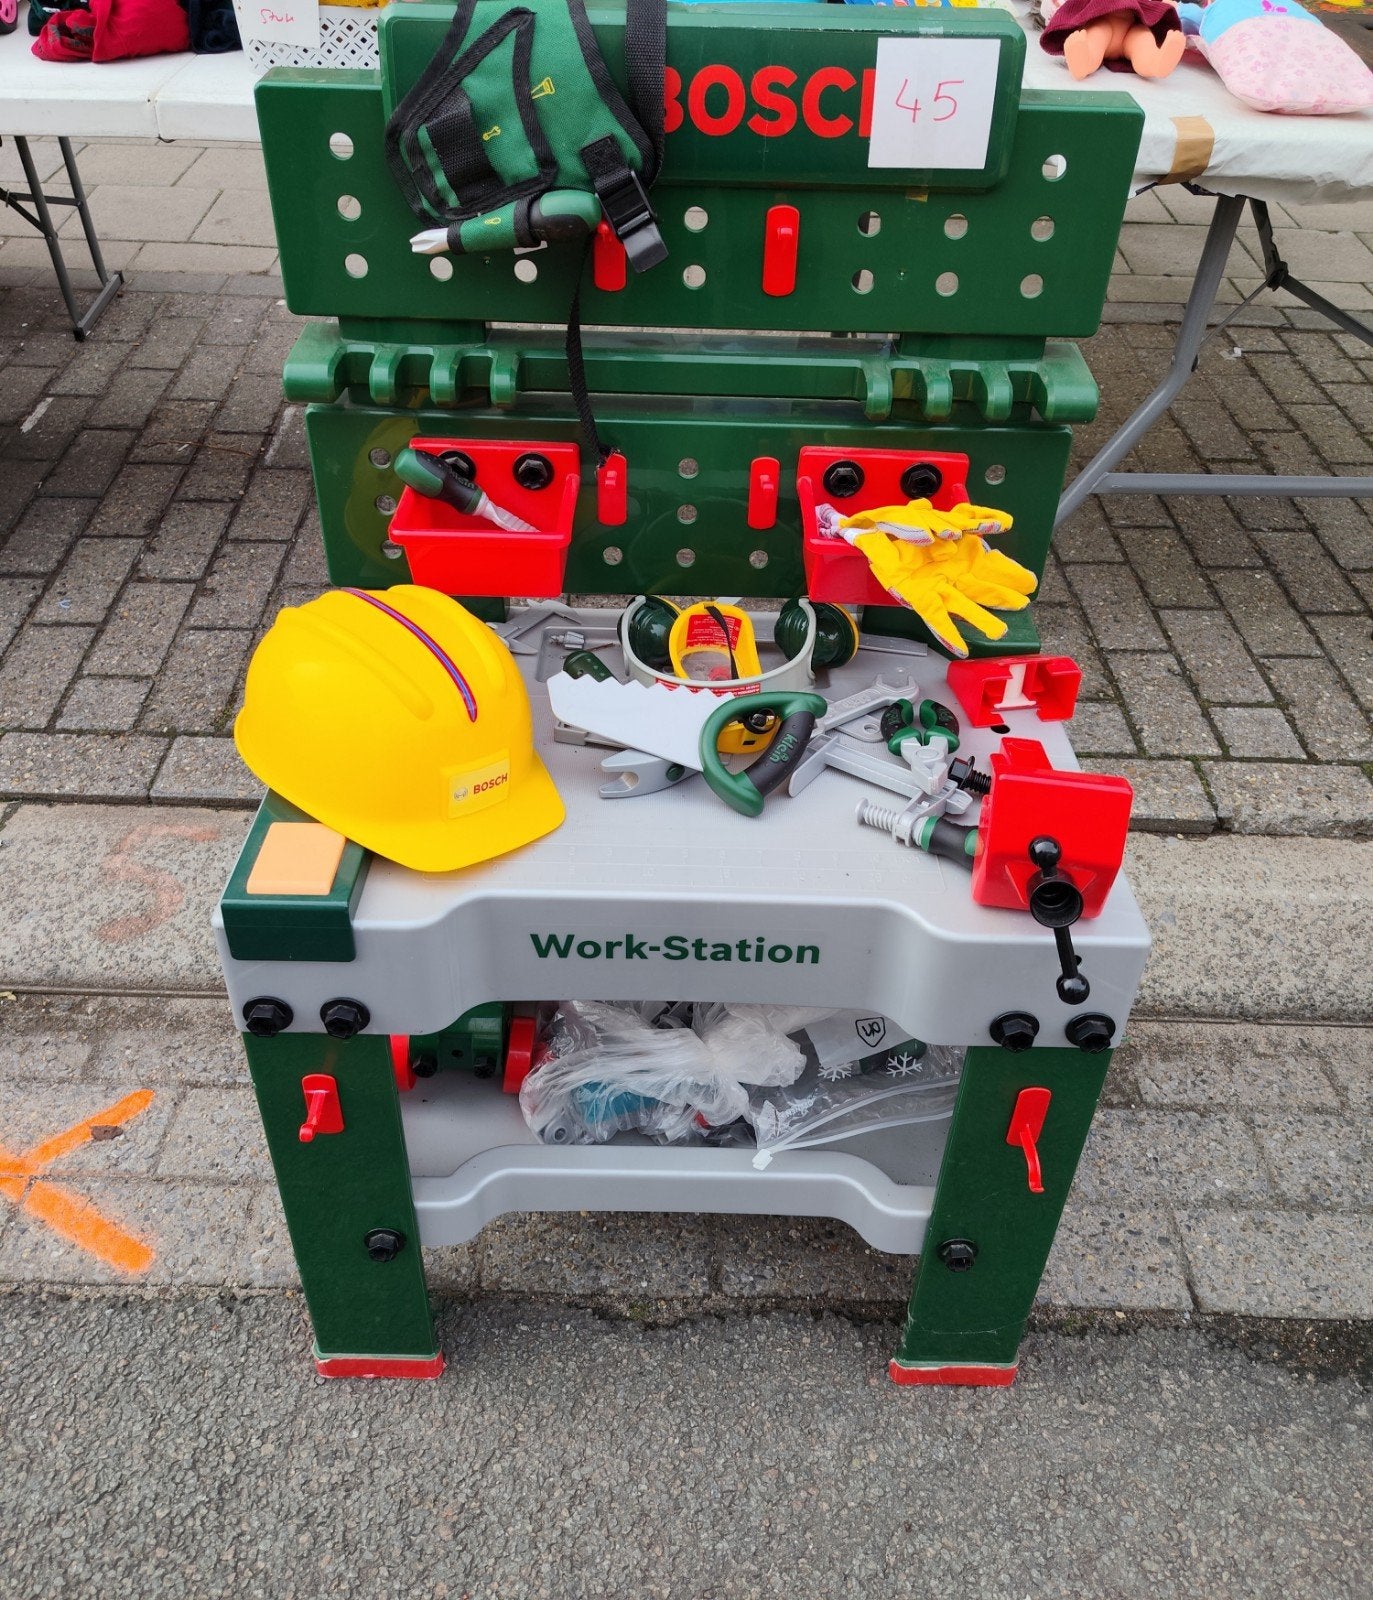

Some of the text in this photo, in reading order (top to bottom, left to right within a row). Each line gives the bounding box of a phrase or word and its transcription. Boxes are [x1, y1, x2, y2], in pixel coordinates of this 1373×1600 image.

[664, 64, 876, 138] OSC
[895, 78, 964, 123] 45
[472, 772, 508, 795] BOSCH
[529, 933, 821, 965] Work-Station
